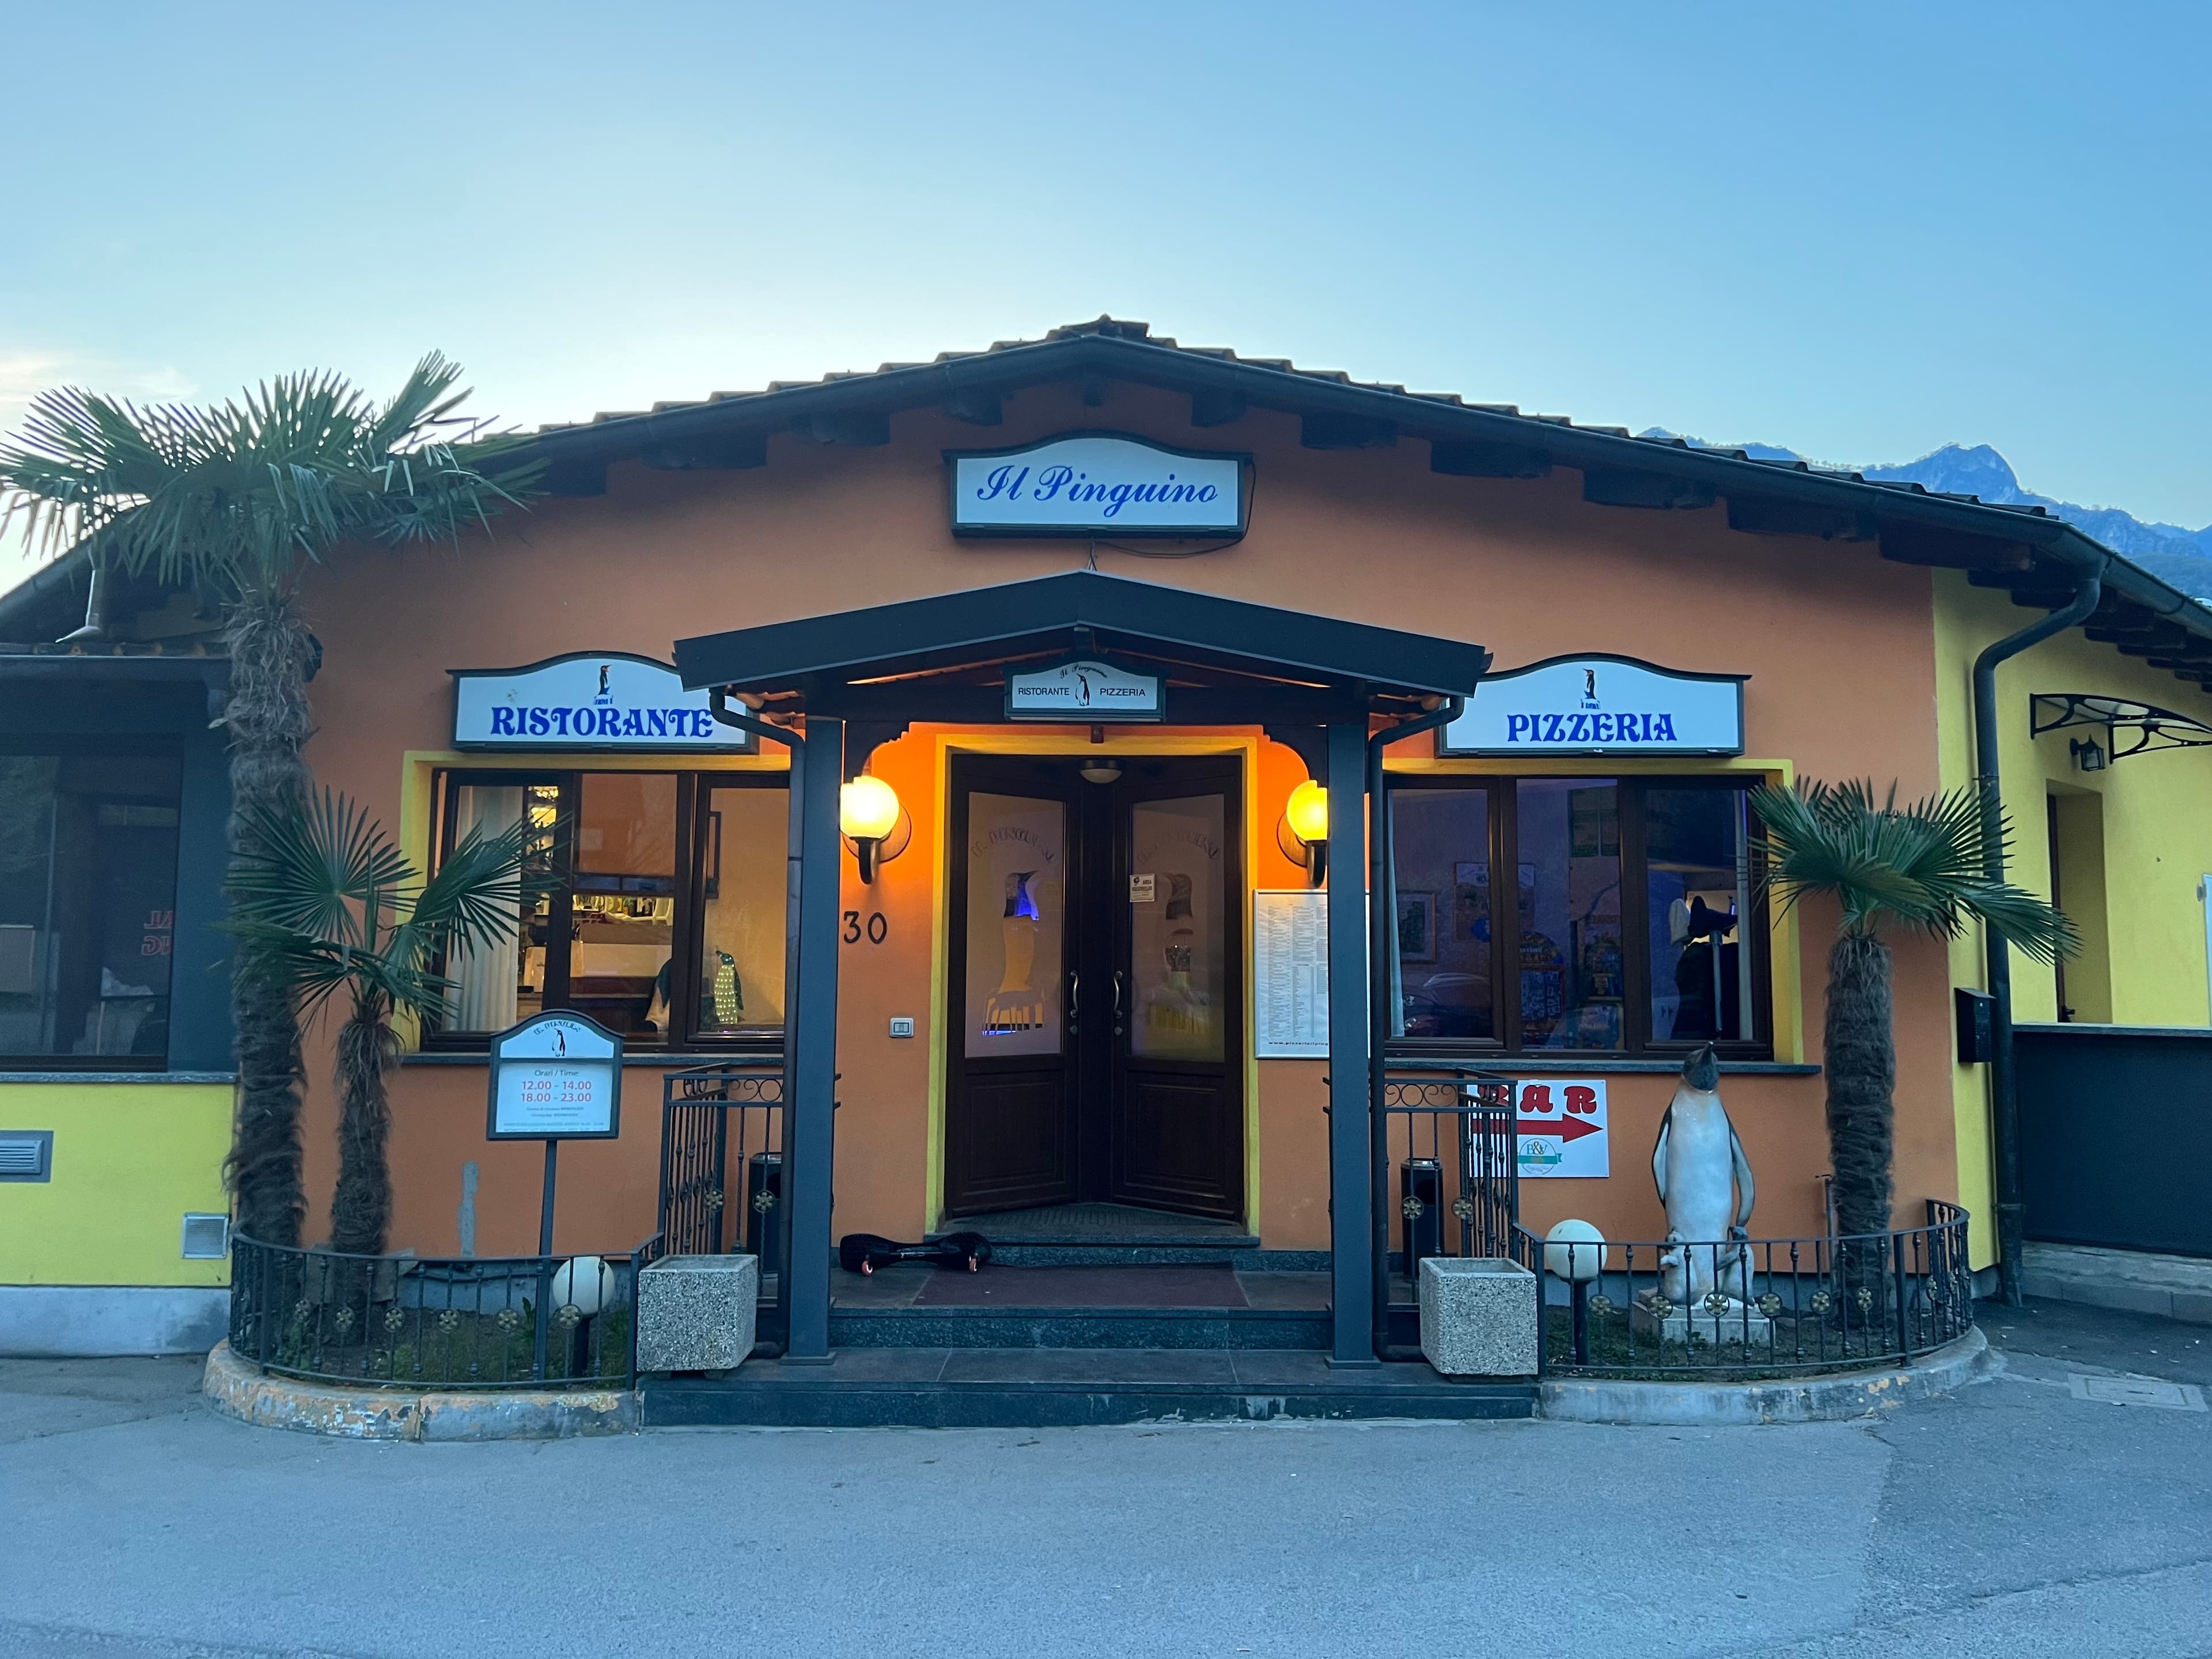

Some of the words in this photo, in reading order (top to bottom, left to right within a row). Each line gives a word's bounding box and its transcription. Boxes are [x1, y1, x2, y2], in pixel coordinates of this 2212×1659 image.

[977, 465, 1030, 501] Il
[1034, 465, 1218, 517] Pinguino
[1018, 687, 1070, 696] RISTORANTE
[1100, 688, 1146, 696] PIZZERIA
[491, 707, 713, 738] RISTORANTE
[1507, 713, 1677, 742] PIZZERIA
[843, 911, 888, 944] 30
[521, 1081, 551, 1090] 12.00
[562, 1081, 592, 1090] 14.00
[521, 1093, 551, 1102] 18.00
[560, 1093, 592, 1102] 23.00
